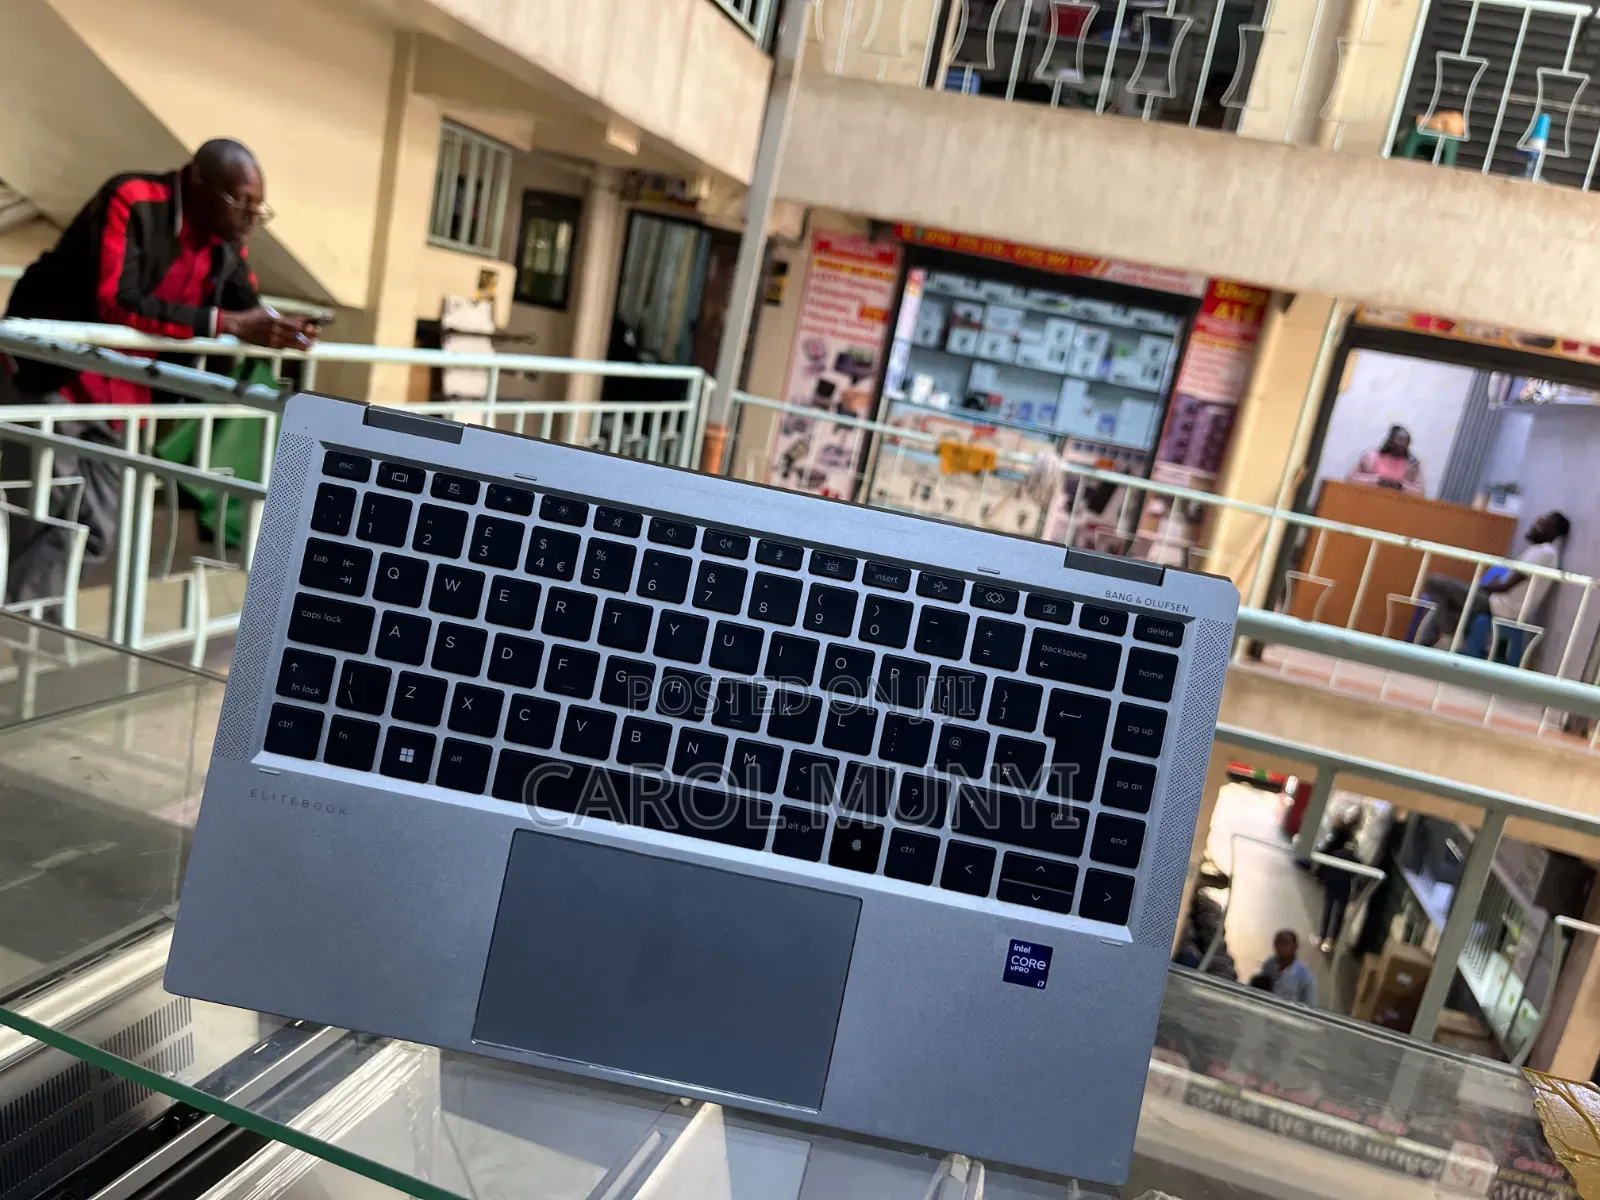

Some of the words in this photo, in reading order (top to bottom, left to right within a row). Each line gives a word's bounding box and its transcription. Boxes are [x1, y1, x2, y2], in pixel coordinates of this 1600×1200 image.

[338, 462, 354, 470] esc
[370, 504, 375, 514] !
[368, 522, 373, 534] 1
[484, 526, 493, 538] £
[423, 534, 432, 546] 2
[540, 537, 548, 550] $
[480, 546, 488, 557] 3
[596, 550, 607, 562] %
[314, 554, 328, 564] tab
[536, 558, 545, 568] 4
[556, 562, 566, 572] €
[388, 567, 400, 580] Q
[592, 568, 601, 580] 5
[707, 573, 716, 584] &
[874, 572, 898, 584] insert
[445, 578, 462, 592] W
[648, 580, 657, 591] 6
[500, 590, 510, 602] E
[704, 591, 713, 602] 7
[818, 594, 824, 606] (
[1105, 590, 1132, 602] BANG
[1144, 598, 1189, 613] OLUFSEN
[556, 601, 566, 614] R
[759, 602, 768, 613] 8
[874, 605, 880, 616] )
[302, 610, 322, 622] caps
[324, 613, 342, 624] lock
[612, 612, 622, 624] T
[815, 613, 824, 624] 9
[389, 626, 401, 638] A
[670, 623, 680, 636] Y
[870, 624, 880, 636] 0
[986, 630, 994, 638] +
[1147, 626, 1174, 638] delete
[446, 636, 456, 648] S
[724, 635, 734, 647] U
[502, 648, 513, 660] D
[778, 646, 784, 657] I
[1042, 644, 1088, 660] backspace
[558, 658, 568, 670] F
[835, 658, 847, 670] O
[616, 670, 627, 683] G
[891, 668, 900, 680] P
[1138, 668, 1164, 680] home
[290, 682, 300, 692] fn
[302, 684, 320, 696] lock
[405, 686, 417, 698] Z
[670, 682, 682, 694] H
[726, 693, 734, 704] J
[1003, 690, 1008, 702] }
[462, 697, 474, 710] X
[519, 708, 530, 721] C
[782, 704, 792, 716] K
[1000, 707, 1006, 720] ]
[278, 718, 294, 728] ctrl
[576, 720, 588, 732] V
[837, 715, 846, 728] L
[338, 731, 348, 740] fn
[631, 730, 642, 742] B
[1127, 724, 1139, 736] pg
[1141, 726, 1154, 737] up
[687, 742, 699, 754] N
[950, 736, 962, 749] @
[450, 754, 462, 764] alt
[744, 753, 757, 766] M
[800, 766, 807, 774] <
[1116, 780, 1128, 790] pg
[1130, 782, 1142, 792] dn
[912, 788, 918, 800] ?
[250, 788, 348, 816] ELITEBOOK
[907, 804, 917, 817] /
[788, 822, 798, 832] alt
[800, 825, 810, 834] gr
[1110, 836, 1128, 846] end
[900, 845, 916, 854] ctrl
[1014, 944, 1031, 954] intel
[1010, 966, 1030, 974] vPRO
